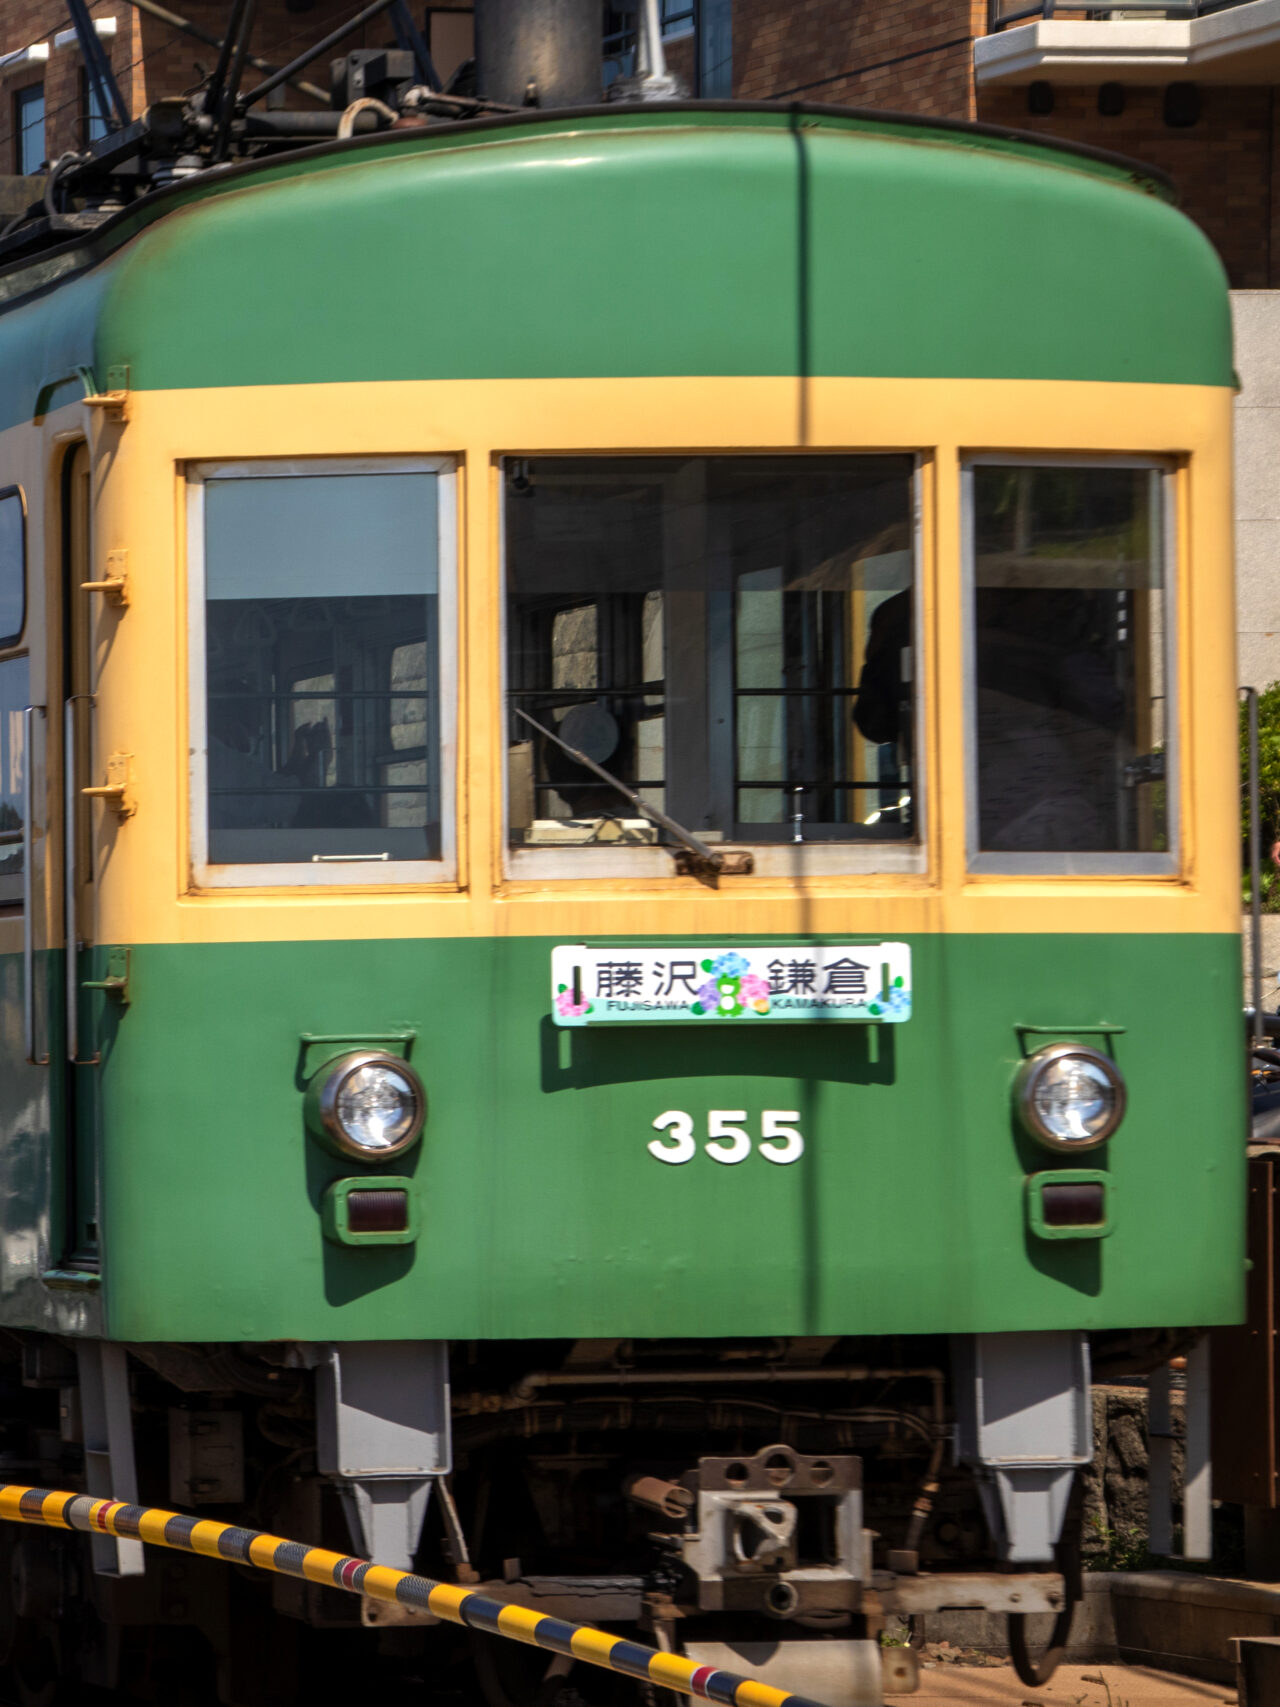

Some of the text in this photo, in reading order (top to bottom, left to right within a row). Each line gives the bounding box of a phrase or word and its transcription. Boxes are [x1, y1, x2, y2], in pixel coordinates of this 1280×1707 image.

[595, 957, 871, 998] 藤沢 鎌倉
[606, 999, 868, 1012] FUJISAWA KAMAKURA
[648, 1110, 805, 1165] 355
